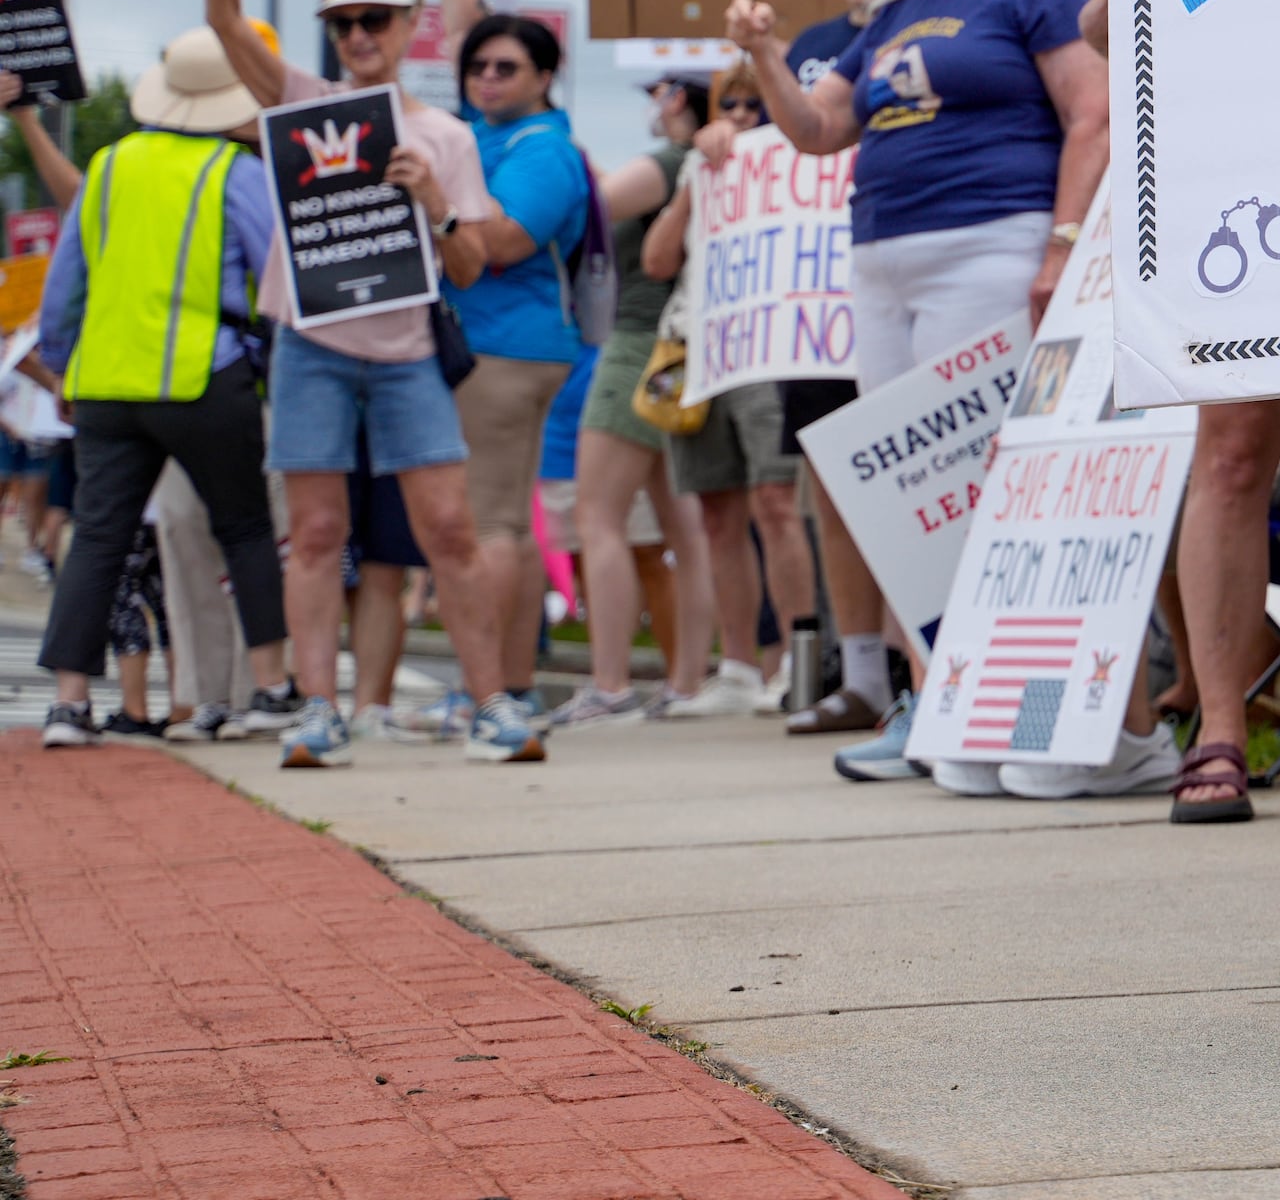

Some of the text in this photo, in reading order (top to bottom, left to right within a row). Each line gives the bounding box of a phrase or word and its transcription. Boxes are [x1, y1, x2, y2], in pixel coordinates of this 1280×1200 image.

[289, 196, 325, 220] NO
[291, 204, 411, 246] NO TRUMP
[704, 227, 783, 308] RIGHT
[704, 303, 778, 386] RIGHT
[934, 330, 1012, 383] VOTE
[852, 387, 988, 481] SHAWN
[897, 468, 928, 492] For
[994, 451, 1059, 523] SAVE
[1052, 444, 1170, 518] AMERICA
[973, 530, 1154, 608] FROM TRUMP!
